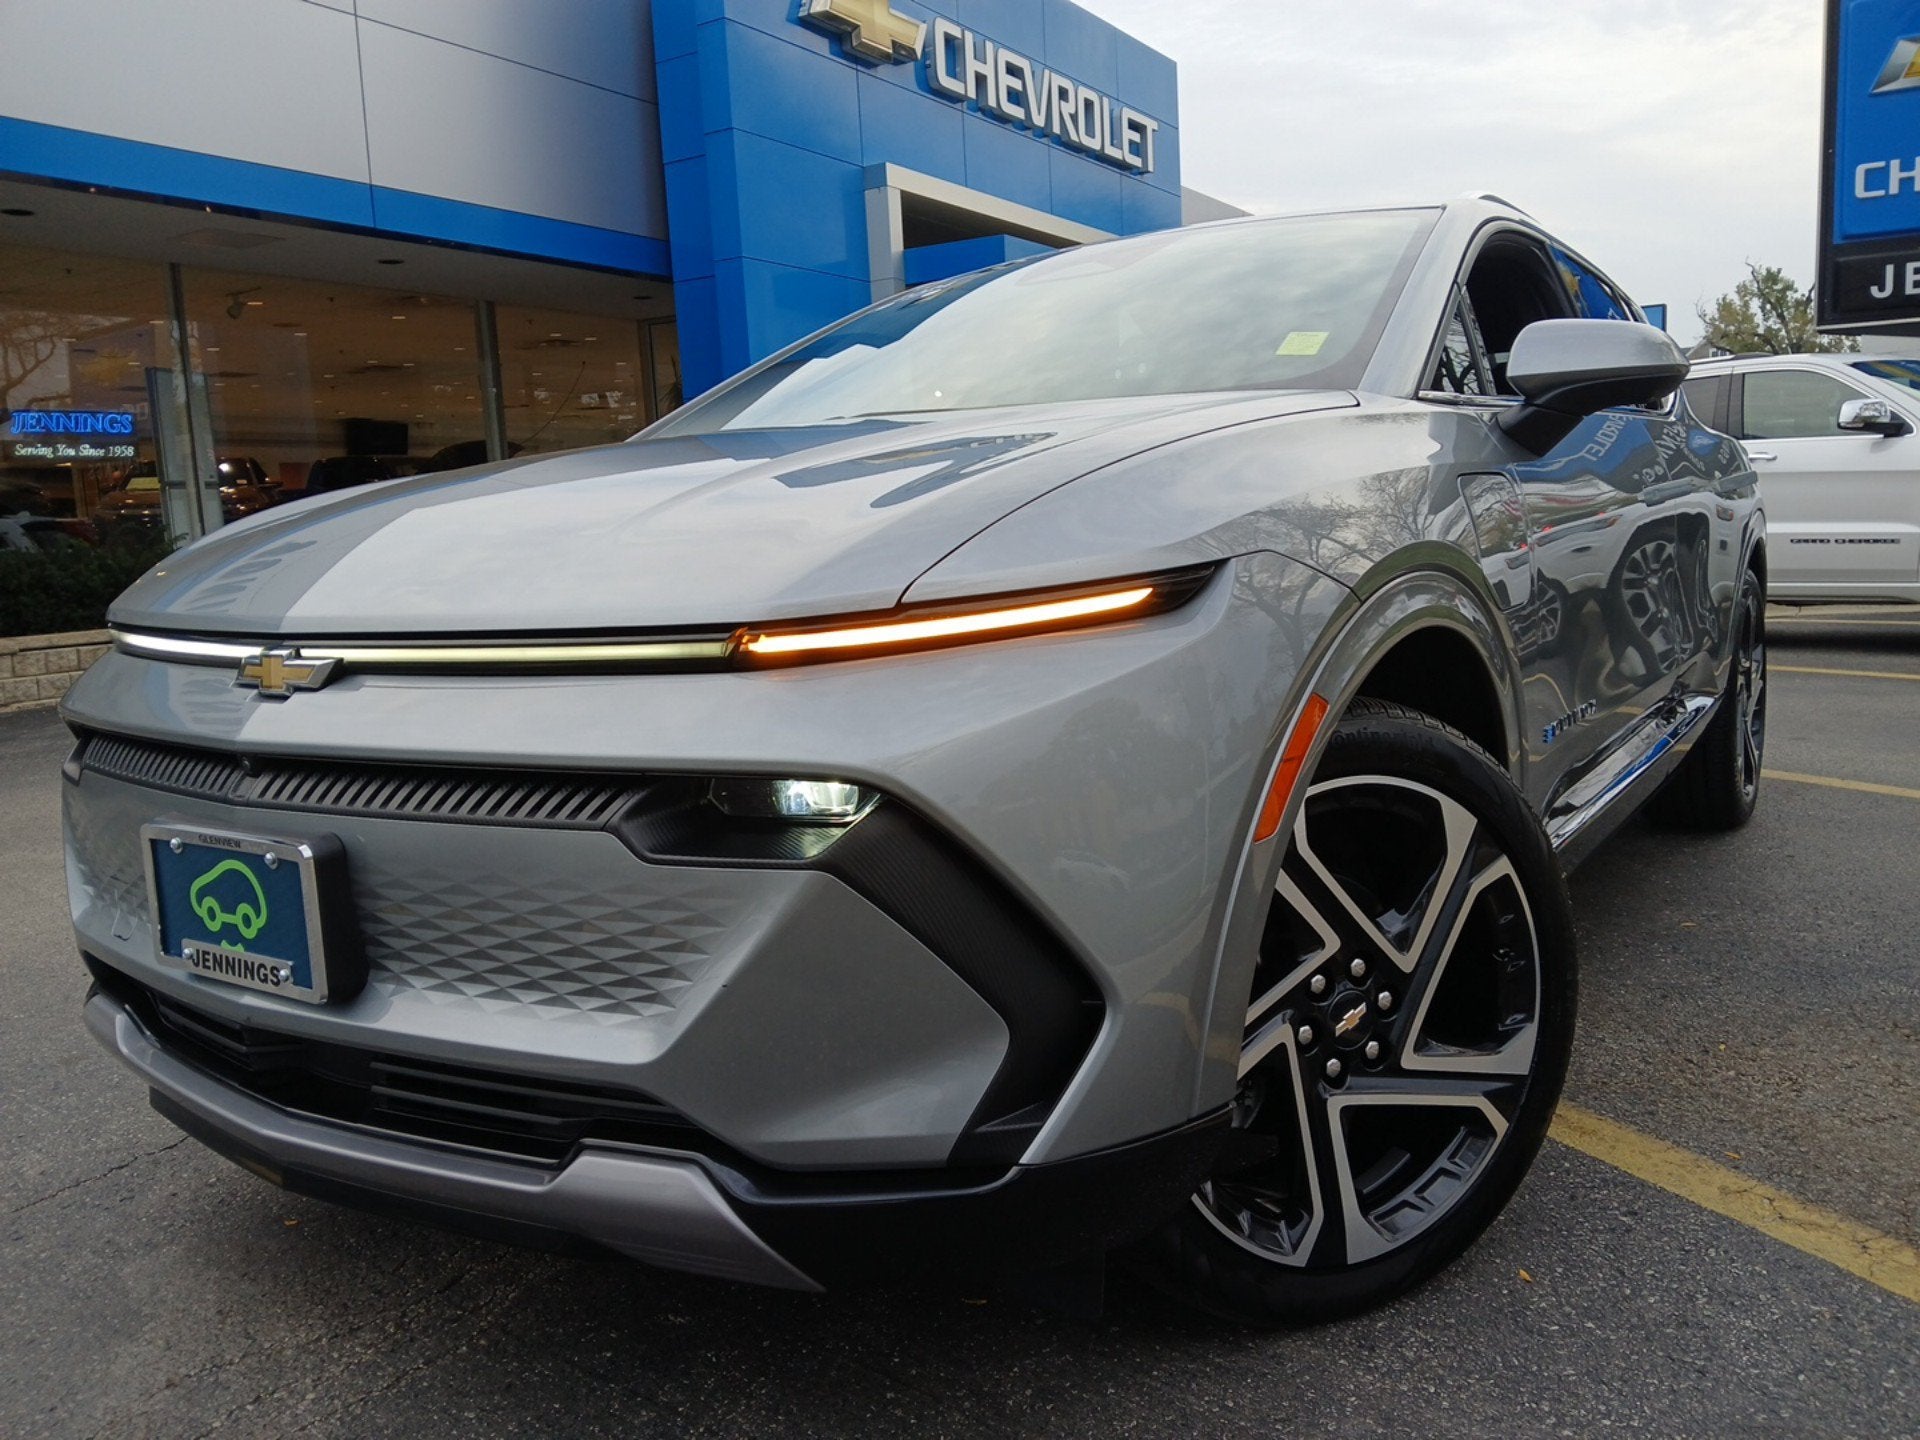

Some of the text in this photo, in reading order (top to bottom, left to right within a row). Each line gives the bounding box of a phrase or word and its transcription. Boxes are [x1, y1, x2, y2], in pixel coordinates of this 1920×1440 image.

[933, 16, 1159, 173] CHEVROLET
[1854, 155, 1920, 199] CH
[11, 411, 133, 434] JENNINGS
[14, 443, 135, 459] Serving You Since 1958
[191, 948, 282, 987] JENNINGS
